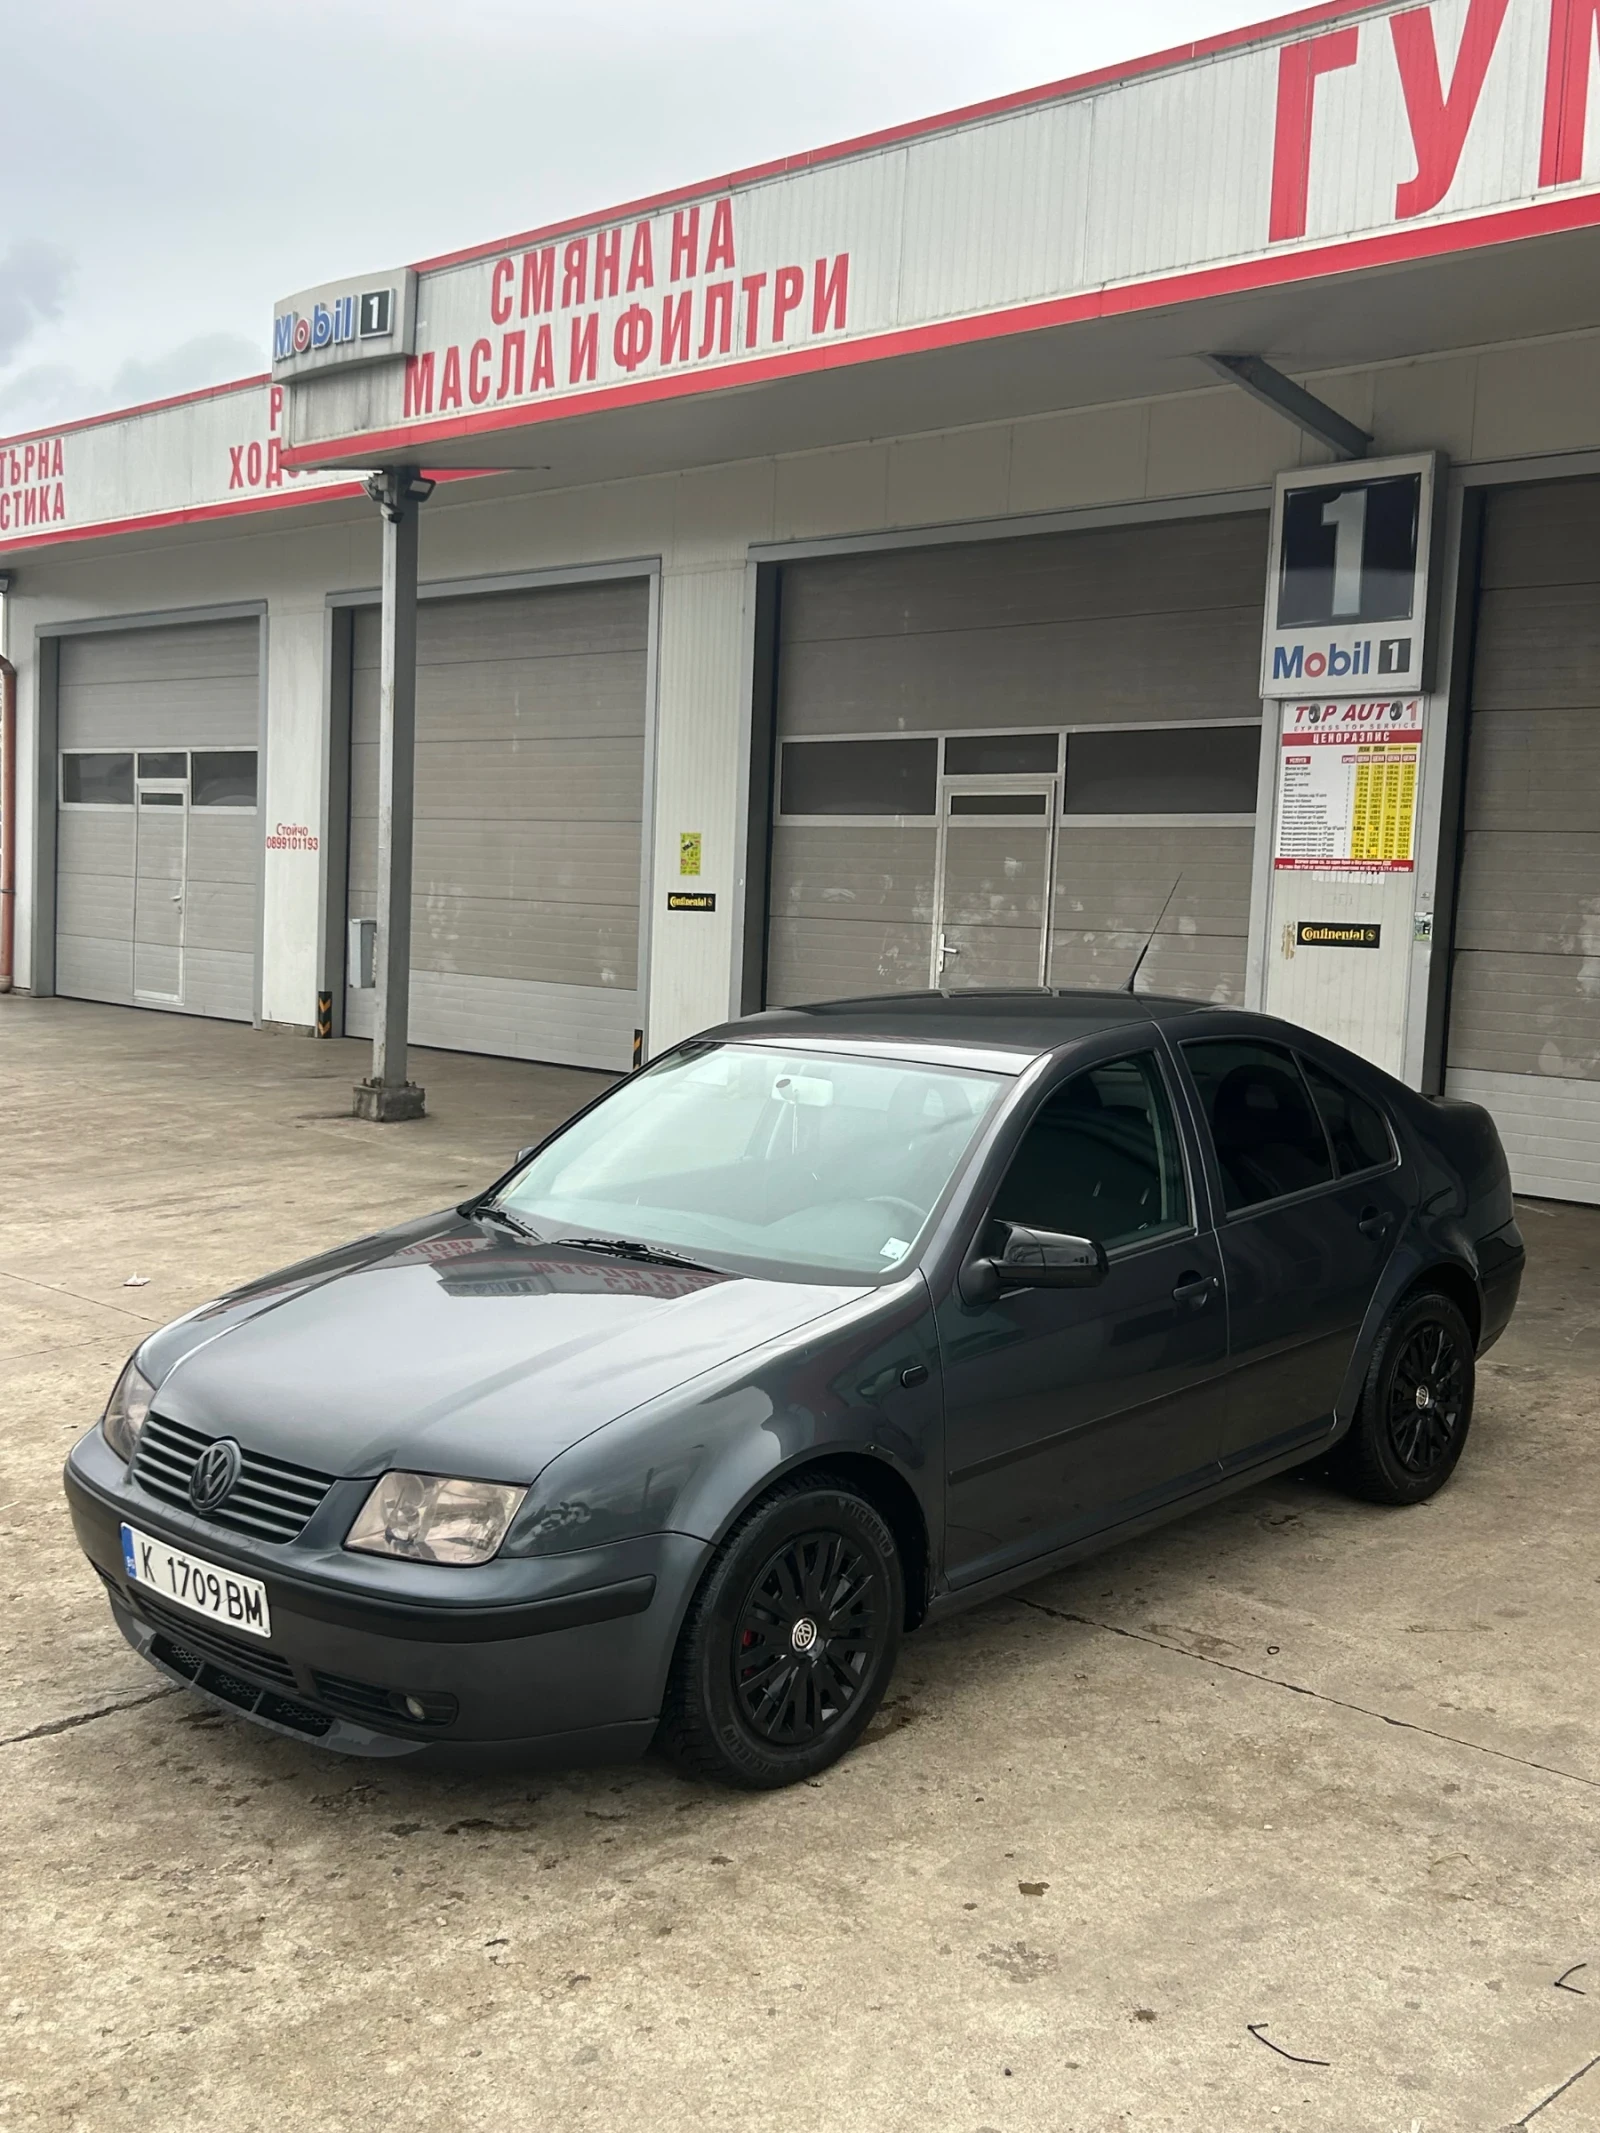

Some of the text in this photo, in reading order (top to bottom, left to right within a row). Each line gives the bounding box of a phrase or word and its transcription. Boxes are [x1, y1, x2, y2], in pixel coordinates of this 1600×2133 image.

[490, 197, 736, 326] СМЯНА НА
[274, 295, 354, 361] Mobil
[403, 252, 850, 418] МАСЛА И ФИЛТРИ
[229, 438, 318, 490] ХОД
[0, 481, 65, 530] СТИКА
[1320, 487, 1369, 616] 1
[1272, 640, 1371, 680] Mobil
[1295, 702, 1337, 724] TOP
[1313, 731, 1390, 743] ЦЕНОРАЗПИС
[266, 836, 319, 851] 0899101193
[276, 822, 309, 837] Стойчо
[669, 896, 707, 908] Continental
[1301, 926, 1365, 942] Continental
[141, 1541, 156, 1583] K
